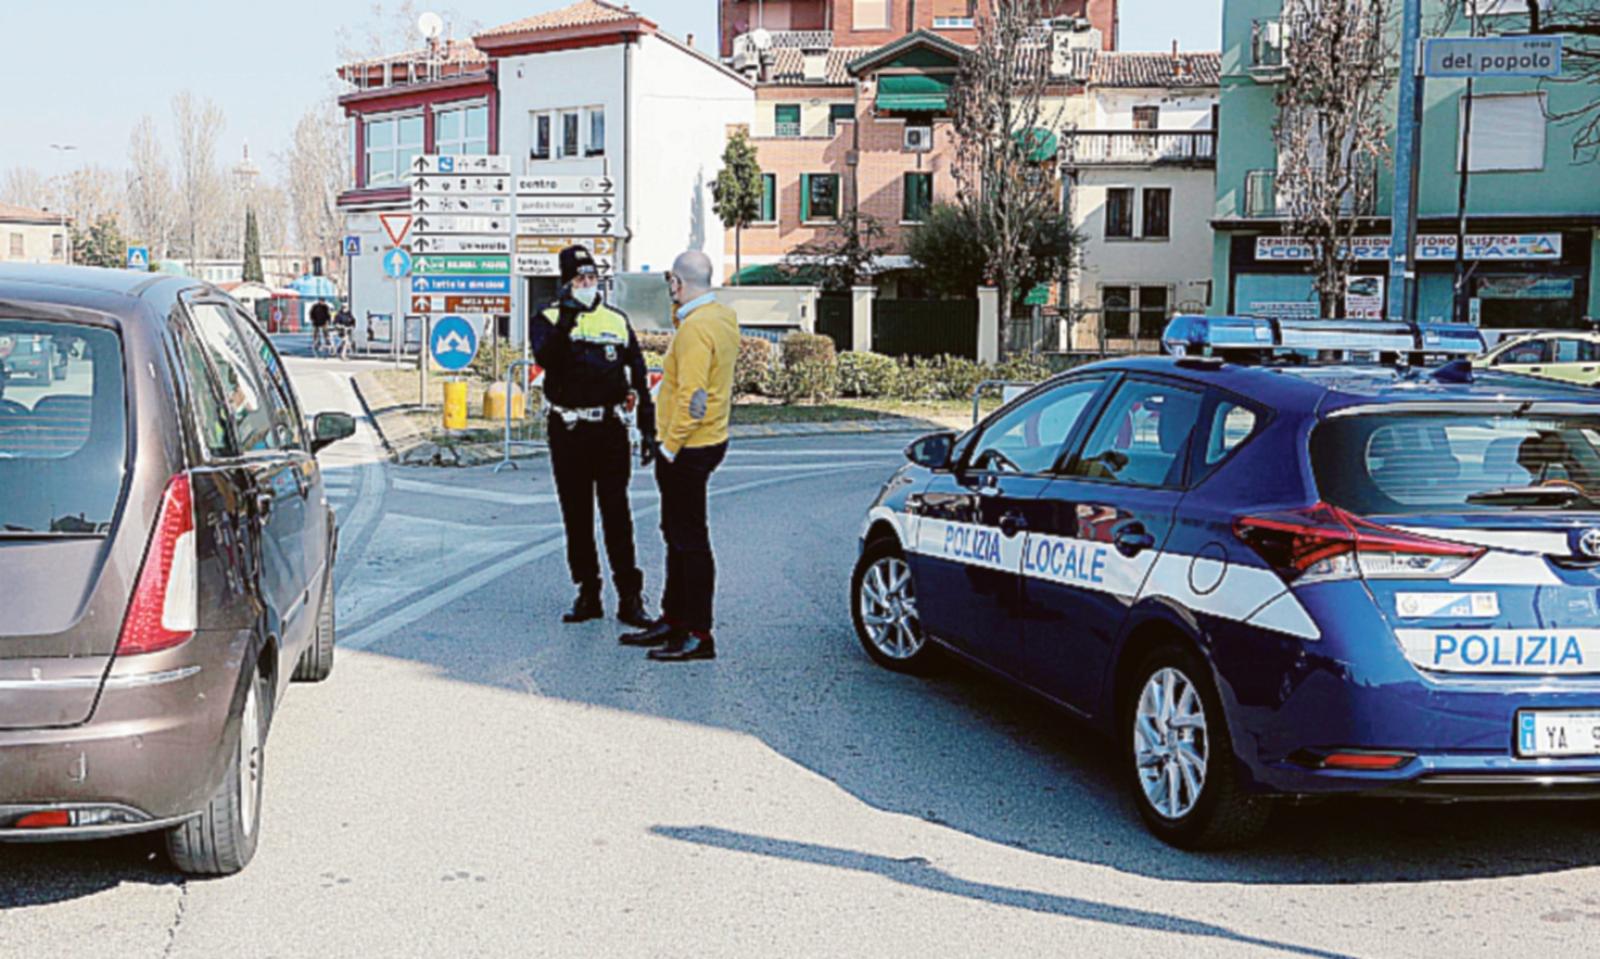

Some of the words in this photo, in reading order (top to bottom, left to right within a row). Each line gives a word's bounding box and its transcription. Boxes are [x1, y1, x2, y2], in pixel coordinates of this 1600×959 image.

[1442, 52, 1472, 69] del
[1480, 52, 1550, 71] popolo
[519, 179, 557, 189] centro
[944, 525, 1001, 562] POLIZIA
[1025, 538, 1107, 583] LOCALE
[1433, 634, 1584, 666] POLIZIA
